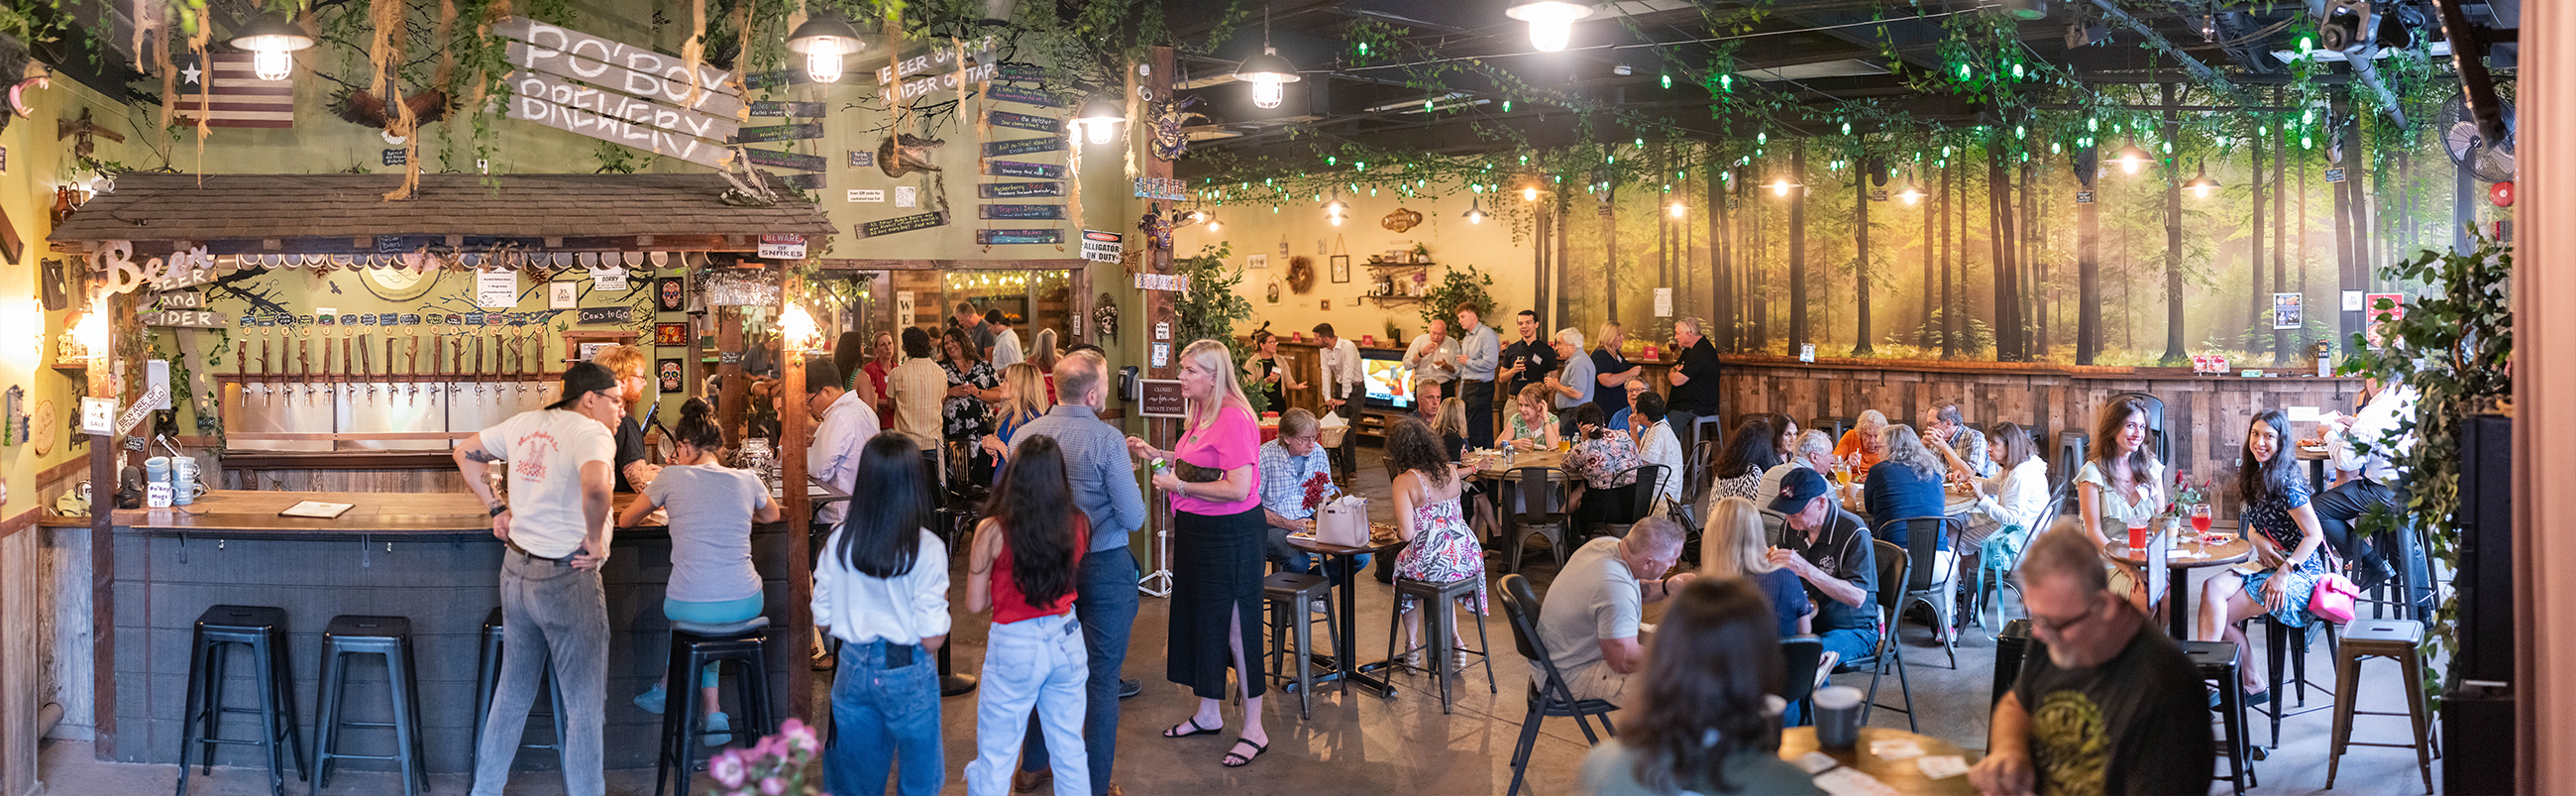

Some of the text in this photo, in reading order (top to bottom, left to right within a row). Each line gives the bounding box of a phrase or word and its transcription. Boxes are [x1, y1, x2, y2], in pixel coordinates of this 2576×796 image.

[525, 19, 729, 108] PO'BOY
[965, 62, 994, 83] TAP
[520, 78, 713, 160] BREWERY
[1083, 242, 1120, 253] ALLIGATOR
[150, 270, 206, 290] EER
[161, 293, 196, 307] and
[150, 311, 212, 325] IDER
[118, 398, 148, 427] BEWARE
[147, 389, 156, 399] OF
[120, 417, 138, 433] ATTACK
